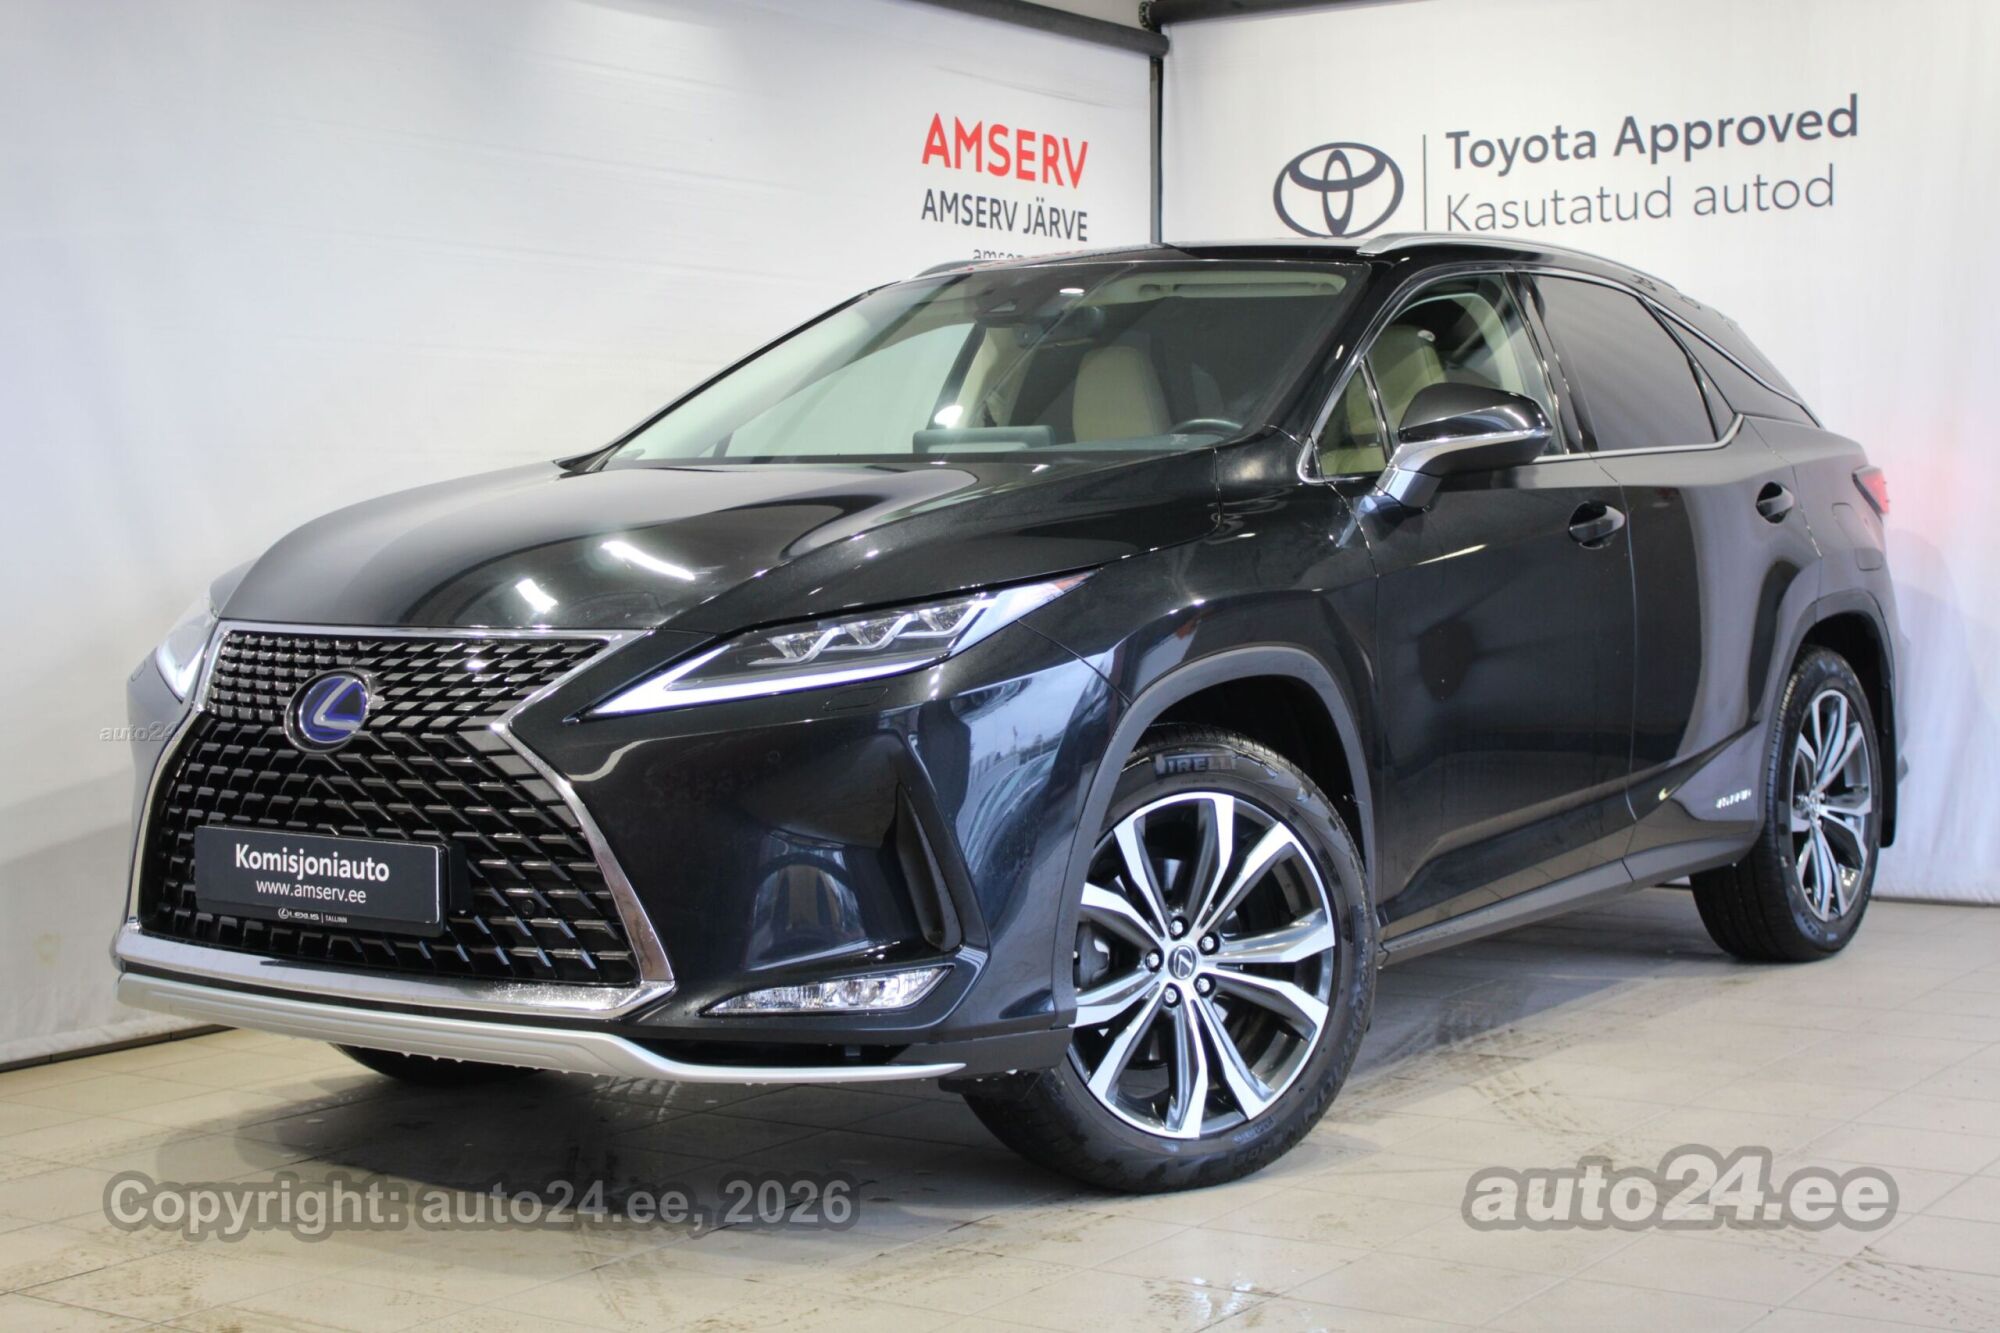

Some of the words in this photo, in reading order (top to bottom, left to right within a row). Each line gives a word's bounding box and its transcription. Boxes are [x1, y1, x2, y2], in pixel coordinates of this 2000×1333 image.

[921, 112, 1089, 190] AMSERV
[1446, 125, 1597, 177] Toyota
[1613, 93, 1858, 165] Approved
[921, 188, 1018, 232] AMSERV
[1023, 196, 1088, 242] JÄRVE
[1447, 176, 1672, 232] Kasutatud
[1693, 163, 1834, 216] autod
[235, 843, 390, 882] Komisjoniauto
[256, 880, 367, 904] www.amserv.ee
